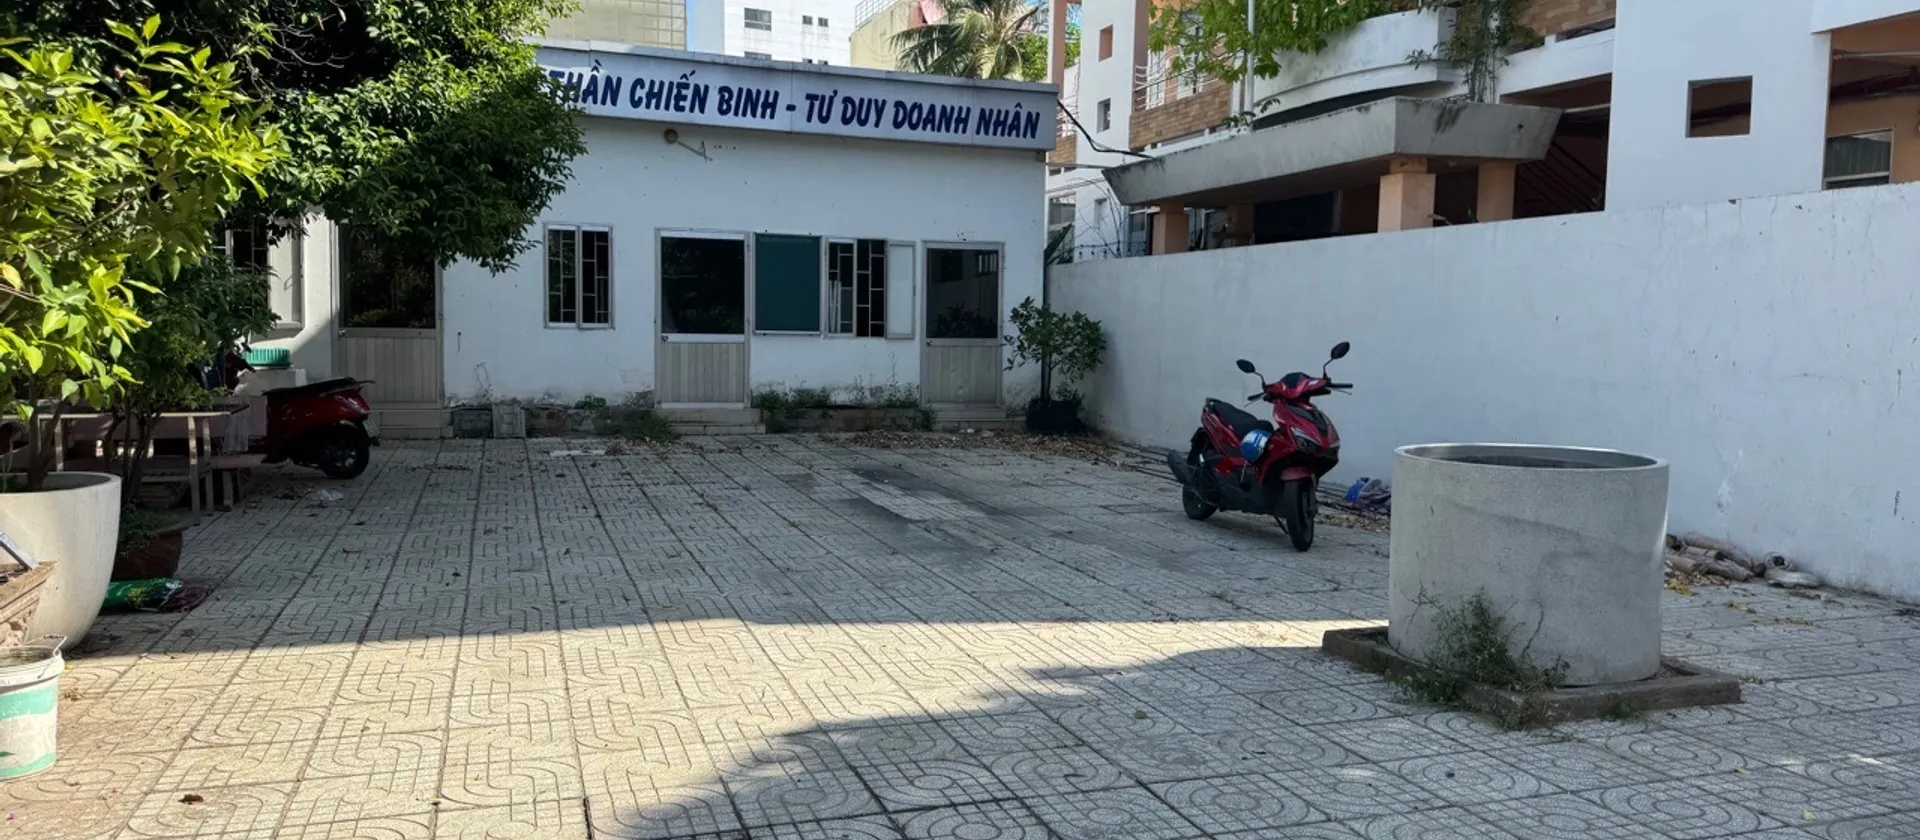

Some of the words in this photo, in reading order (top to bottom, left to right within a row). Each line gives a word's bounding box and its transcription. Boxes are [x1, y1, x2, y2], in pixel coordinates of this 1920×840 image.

[629, 70, 709, 114] CHIẾN
[717, 86, 780, 120] BINH
[805, 90, 838, 124] TƯ
[840, 96, 887, 128] DUY
[892, 102, 971, 134] DOANH
[975, 102, 1040, 139] NHÂN
